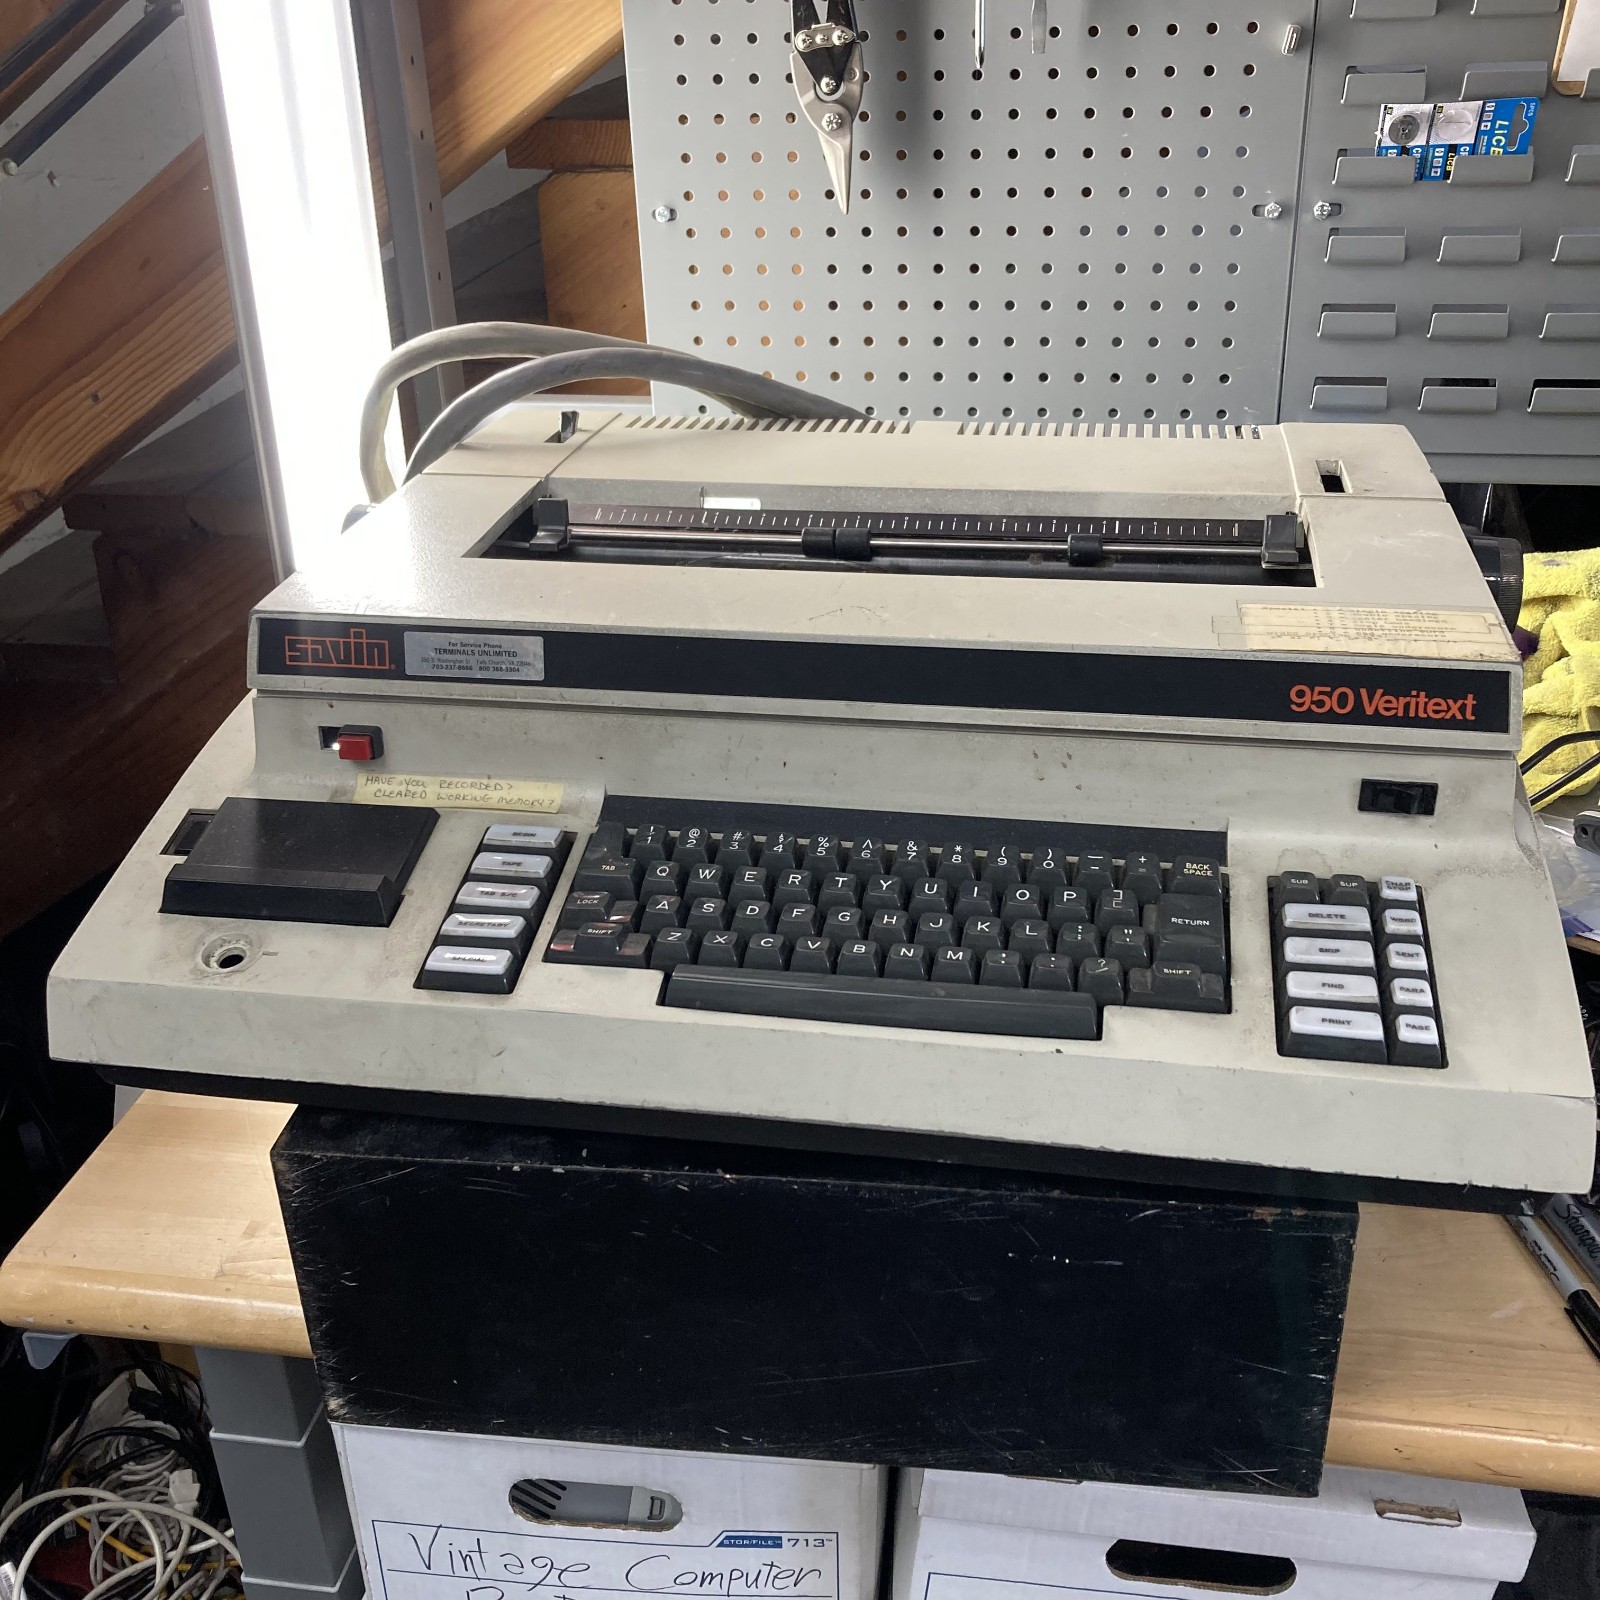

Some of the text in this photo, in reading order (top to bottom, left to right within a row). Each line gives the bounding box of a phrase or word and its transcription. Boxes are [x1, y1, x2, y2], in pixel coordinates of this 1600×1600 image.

[434, 648, 517, 658] TERMINALS UNLIMITED
[1289, 684, 1477, 720] 950 Veritext
[365, 776, 396, 787] HAVE
[374, 788, 427, 799] CLEARED
[436, 792, 493, 803] WORKING
[686, 839, 696, 848] 2
[729, 841, 739, 850] 3
[773, 844, 783, 853] 4
[817, 847, 826, 856] 5
[861, 850, 871, 858] 6
[907, 852, 917, 861] 7
[951, 854, 962, 863] 8
[997, 857, 1008, 866] 9
[1185, 862, 1210, 870] BACK
[657, 866, 669, 877] Q
[699, 869, 716, 880] W
[744, 871, 757, 882] E
[1183, 868, 1213, 877] SPACE
[788, 874, 801, 885] R
[835, 877, 848, 888] T
[880, 879, 892, 890] Y
[924, 882, 937, 894] U
[1063, 891, 1077, 902] P
[656, 900, 669, 911] A
[702, 903, 714, 913] S
[746, 905, 759, 915] D
[791, 908, 806, 918] F
[838, 911, 850, 922] G
[1308, 912, 1347, 920] DELETE
[883, 914, 897, 924] H
[930, 918, 943, 928] J
[1171, 917, 1210, 926] RETURN
[977, 921, 990, 932] K
[1025, 924, 1038, 935] L
[667, 932, 682, 942] Z
[713, 934, 728, 944] X
[760, 938, 774, 947] C
[807, 940, 822, 950] V
[853, 944, 866, 954] B
[901, 947, 914, 957] N
[947, 951, 963, 960] M
[1163, 967, 1192, 975] SHIFT
[1321, 1017, 1352, 1026] PRINT
[408, 1524, 822, 1597] Vintage Computer
